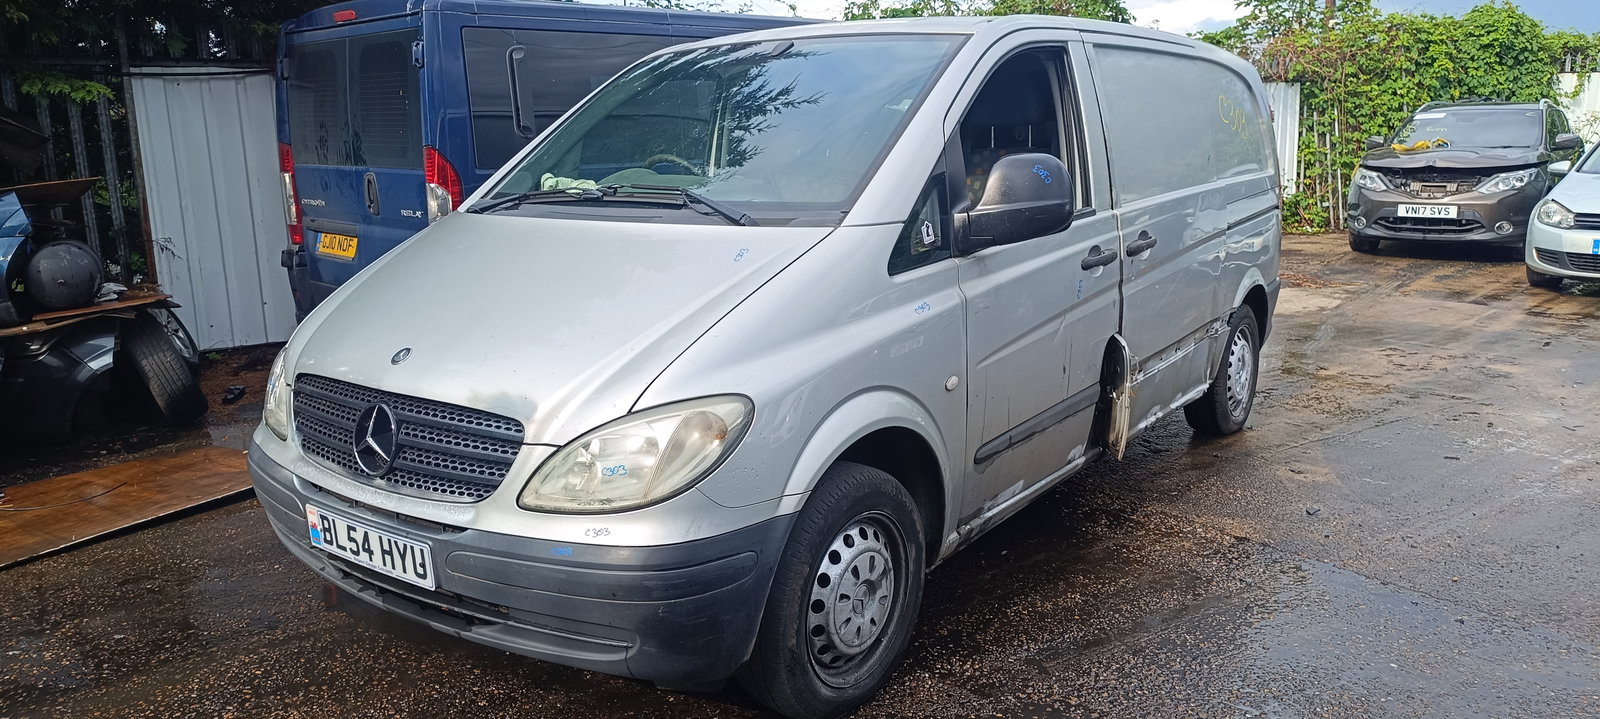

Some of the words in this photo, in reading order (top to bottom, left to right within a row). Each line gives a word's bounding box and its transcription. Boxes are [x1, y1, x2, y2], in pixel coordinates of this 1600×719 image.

[1032, 164, 1052, 184] C303
[1405, 206, 1426, 216] VN17
[1429, 206, 1450, 216] SVS
[601, 464, 628, 477] C303
[584, 527, 611, 538] C303
[319, 513, 375, 563] BL54
[379, 535, 428, 581] HYU
